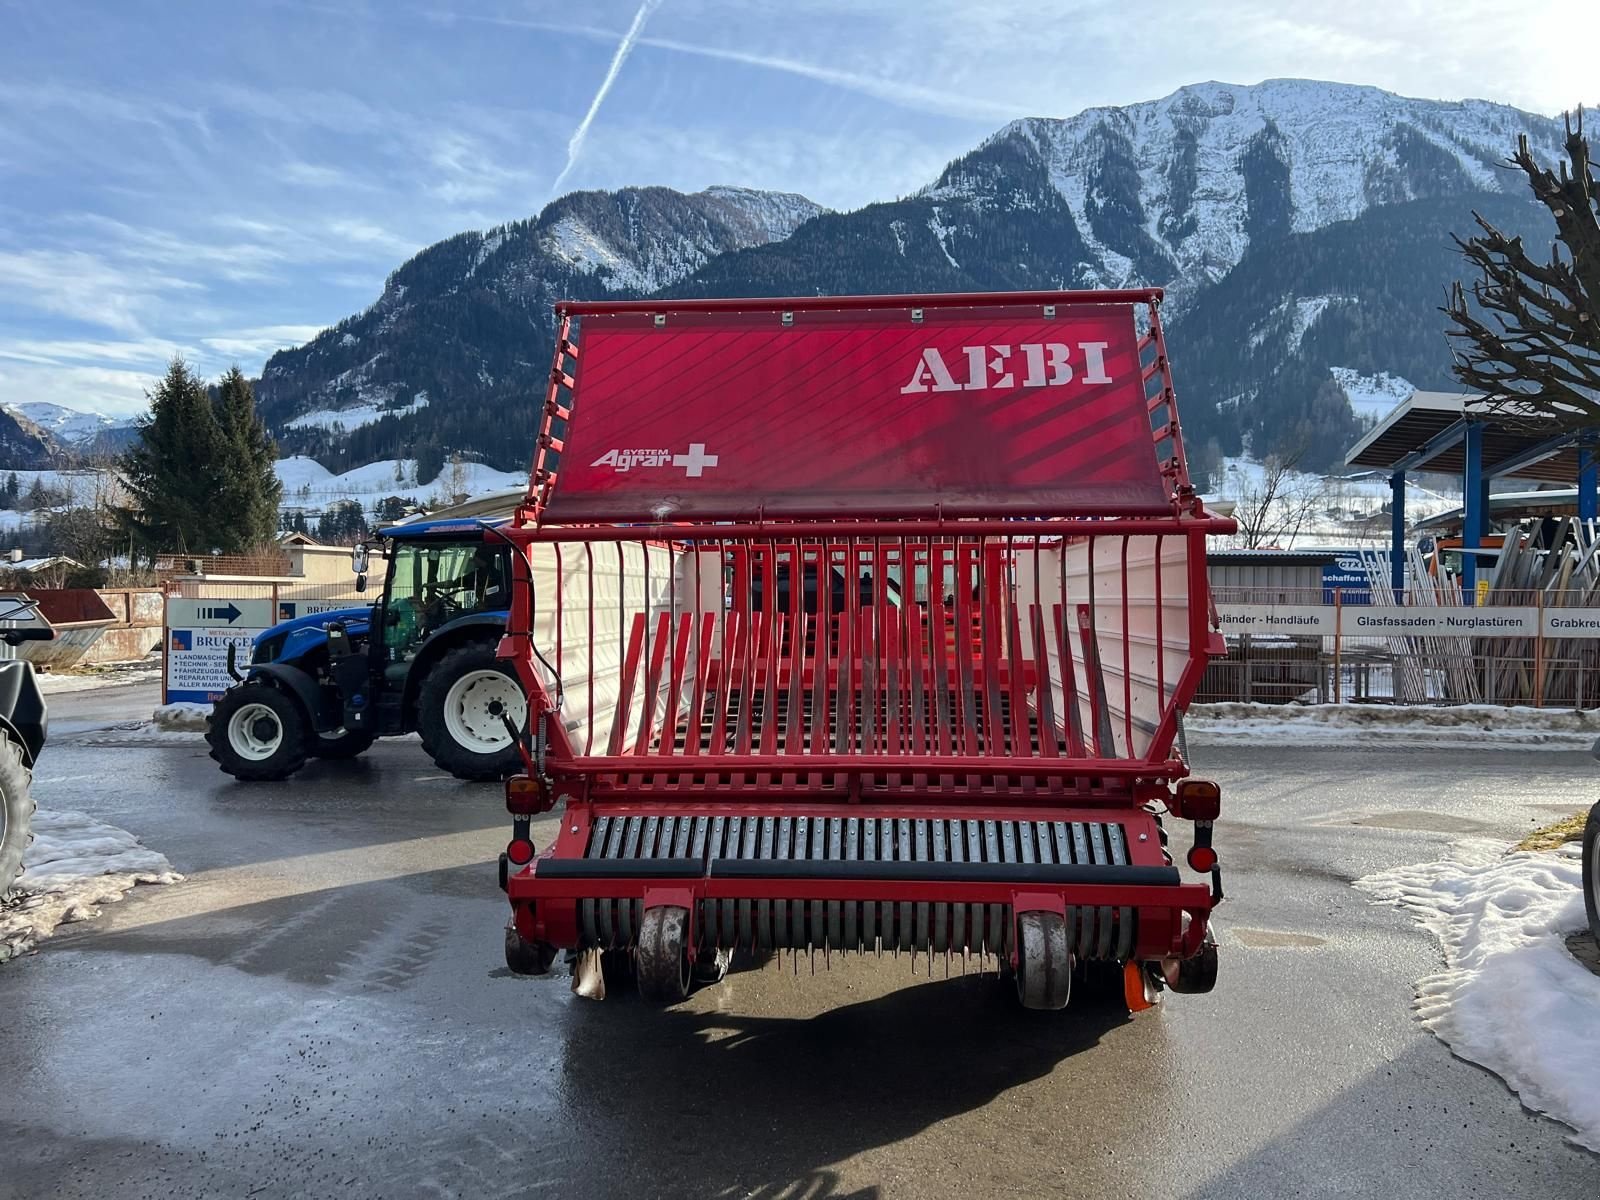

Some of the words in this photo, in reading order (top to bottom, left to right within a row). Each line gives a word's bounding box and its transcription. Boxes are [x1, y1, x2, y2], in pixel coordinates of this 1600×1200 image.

[900, 341, 1113, 394] AEBI
[590, 449, 671, 472] Agrar
[1216, 614, 1256, 624] eländer
[1265, 615, 1320, 625] Handläufe
[1356, 616, 1436, 627] Glasfassaden
[1446, 616, 1523, 629] Nurglastüren
